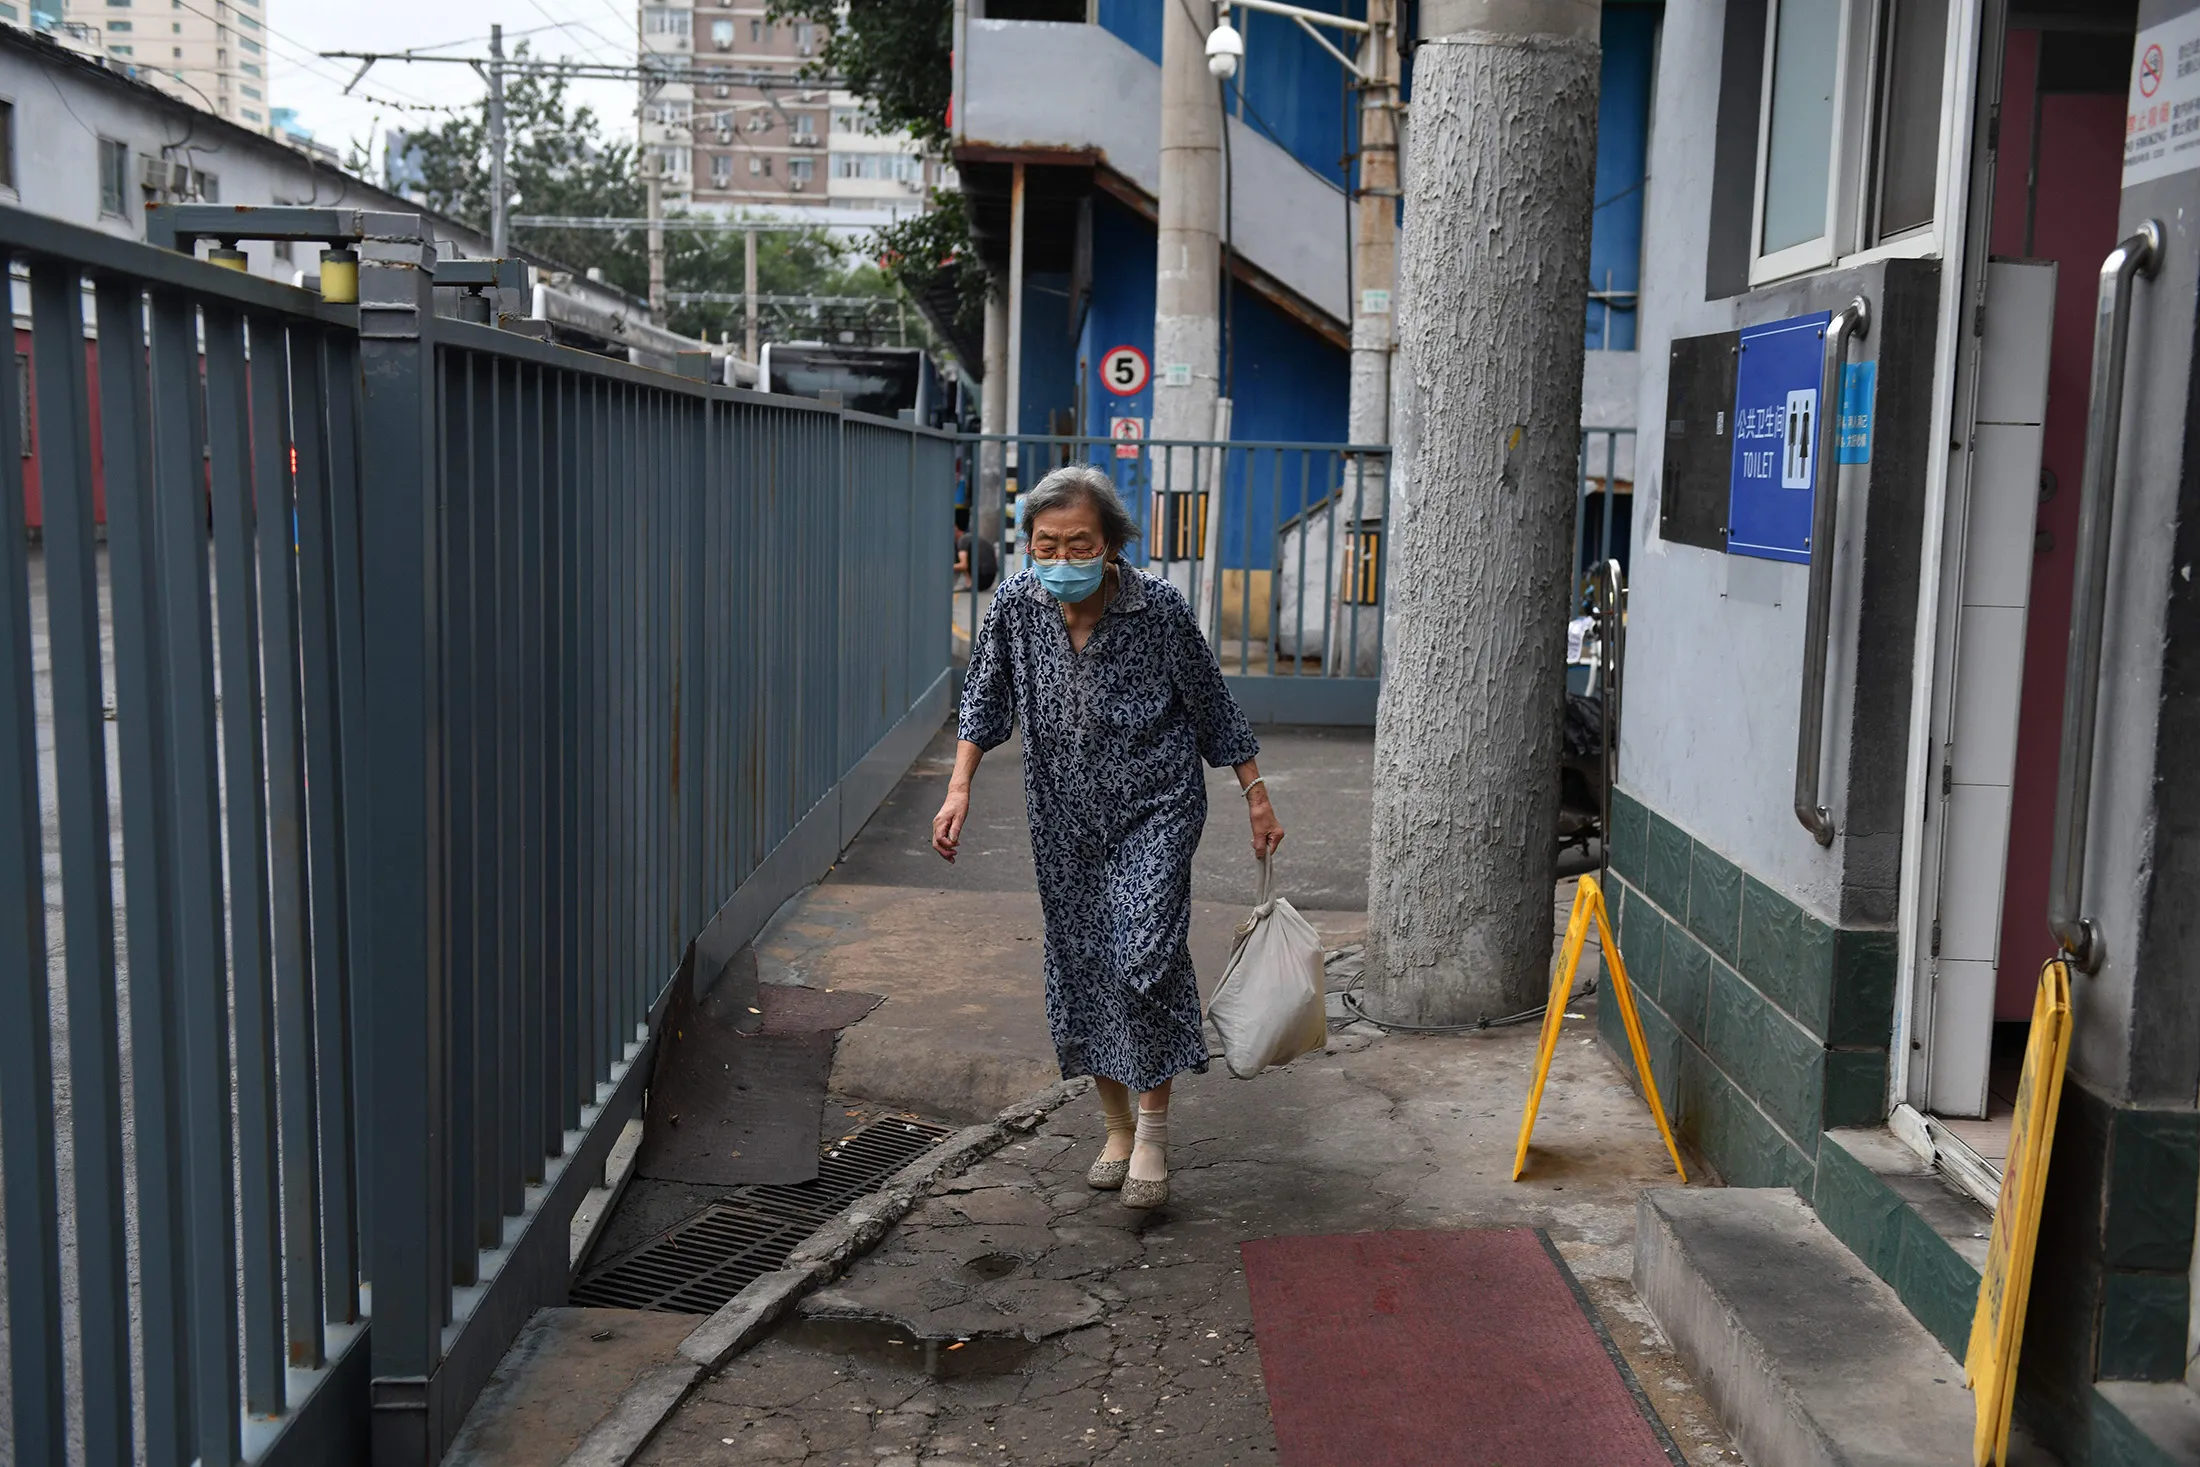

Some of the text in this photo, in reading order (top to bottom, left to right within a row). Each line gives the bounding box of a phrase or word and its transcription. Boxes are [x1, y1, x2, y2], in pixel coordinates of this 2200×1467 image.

[1115, 357, 1134, 384] 5
[1737, 405, 1785, 439] 公共卫生间
[1743, 451, 1774, 479] TOILET
